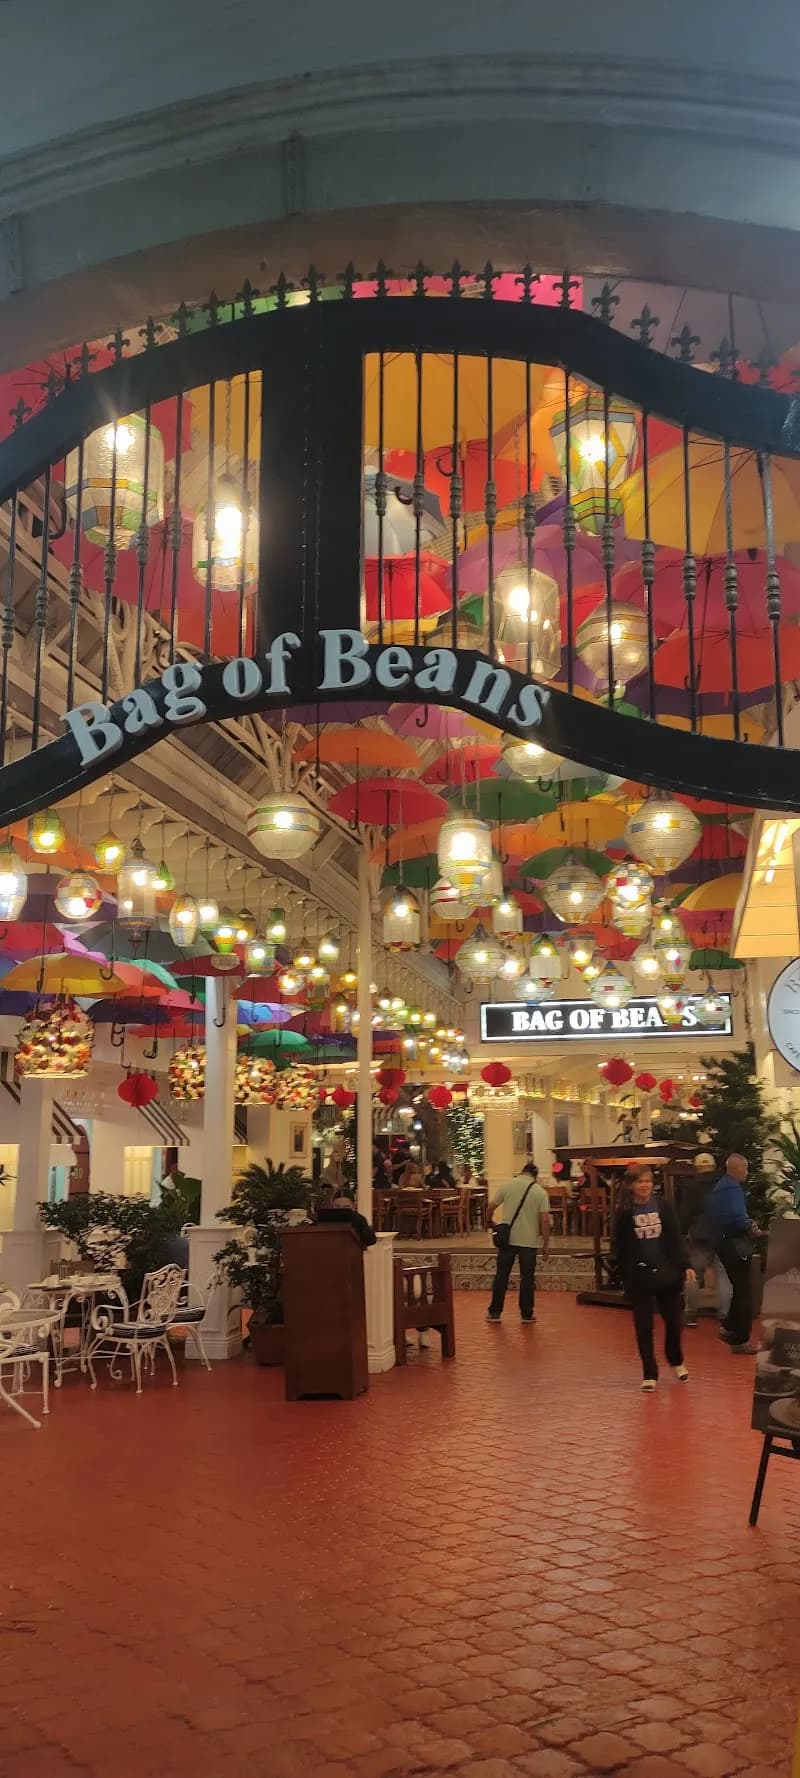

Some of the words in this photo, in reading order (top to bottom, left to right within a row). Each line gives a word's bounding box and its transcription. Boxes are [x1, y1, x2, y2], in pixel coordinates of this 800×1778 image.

[60, 661, 207, 767] Bag
[222, 631, 301, 700] of
[317, 628, 551, 728] Beans
[511, 1010, 564, 1032] BAG
[569, 1009, 605, 1030] OF
[610, 1004, 698, 1029] BEAS
